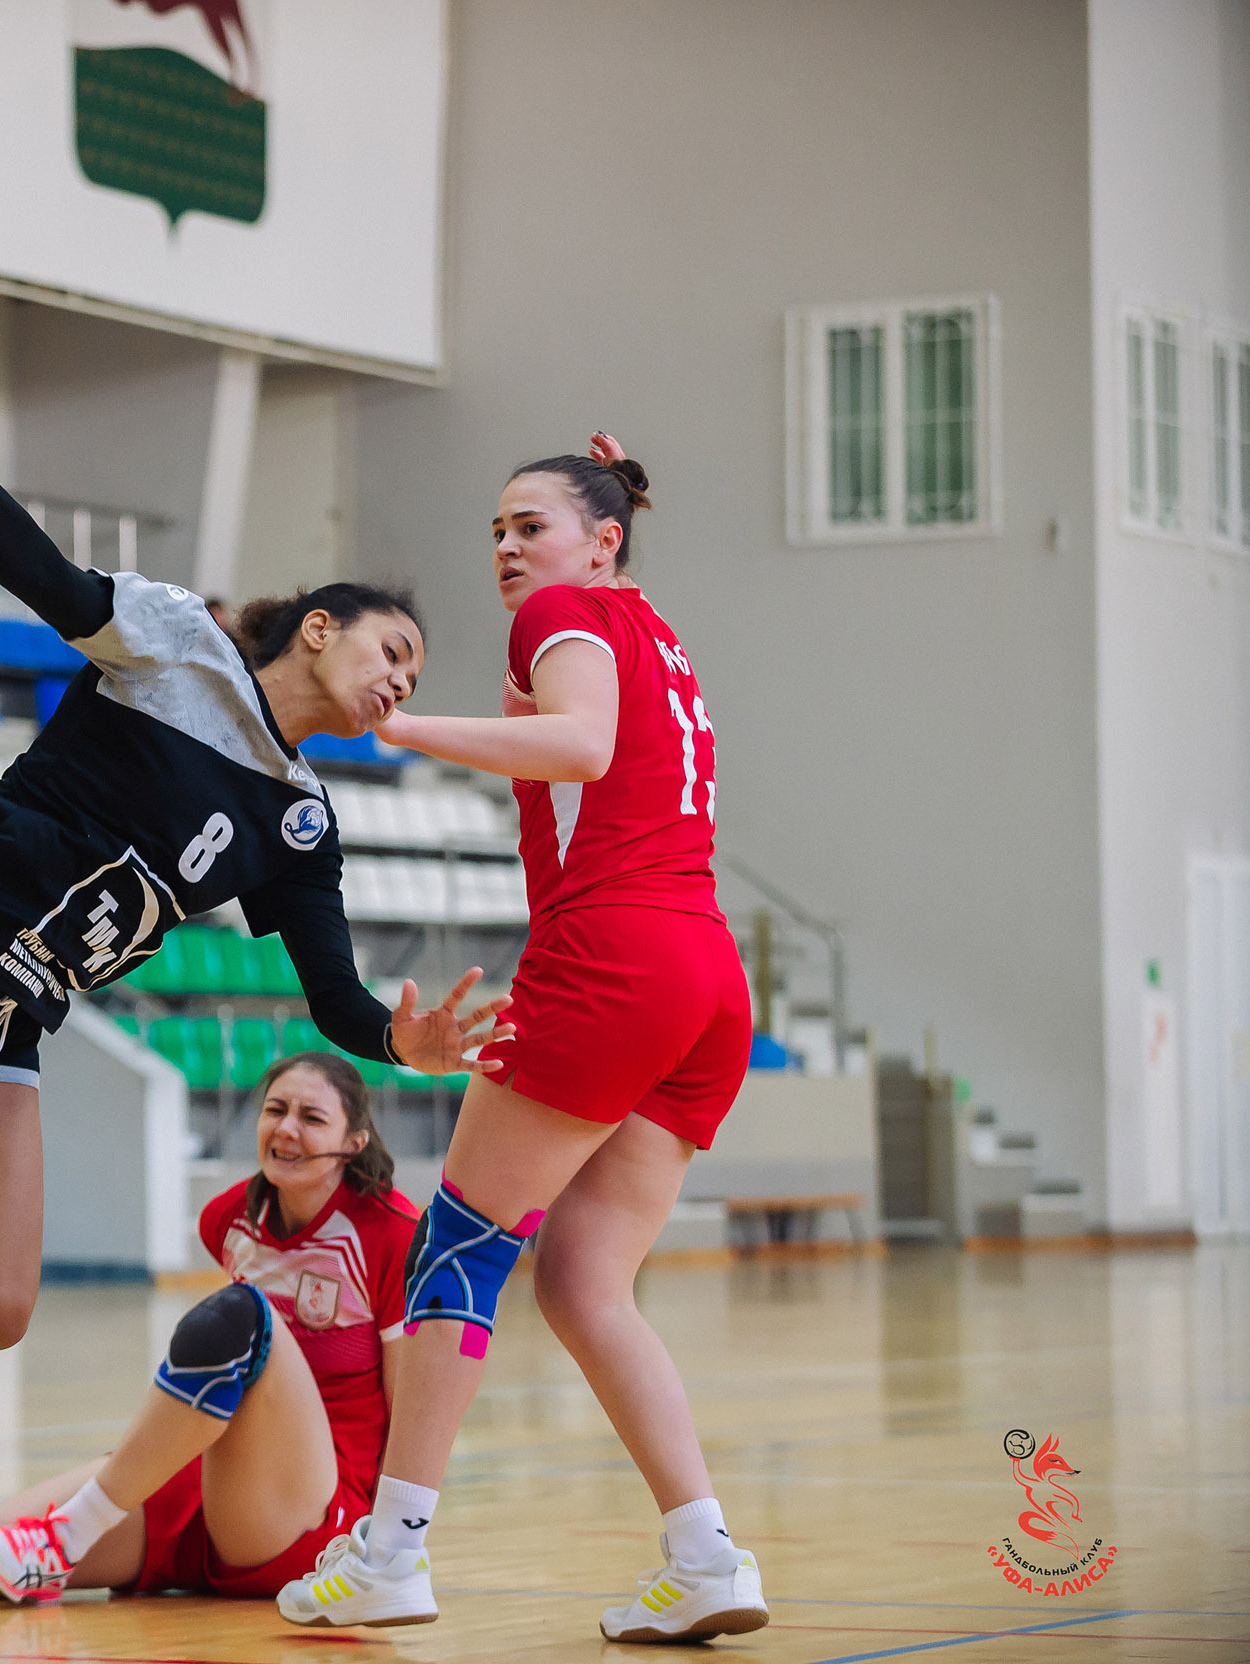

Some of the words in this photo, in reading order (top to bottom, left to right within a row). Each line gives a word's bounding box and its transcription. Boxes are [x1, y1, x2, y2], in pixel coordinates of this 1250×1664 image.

[178, 812, 234, 883] 8
[16, 928, 55, 963] ТРУБНАЯ
[81, 889, 119, 973] ТМК
